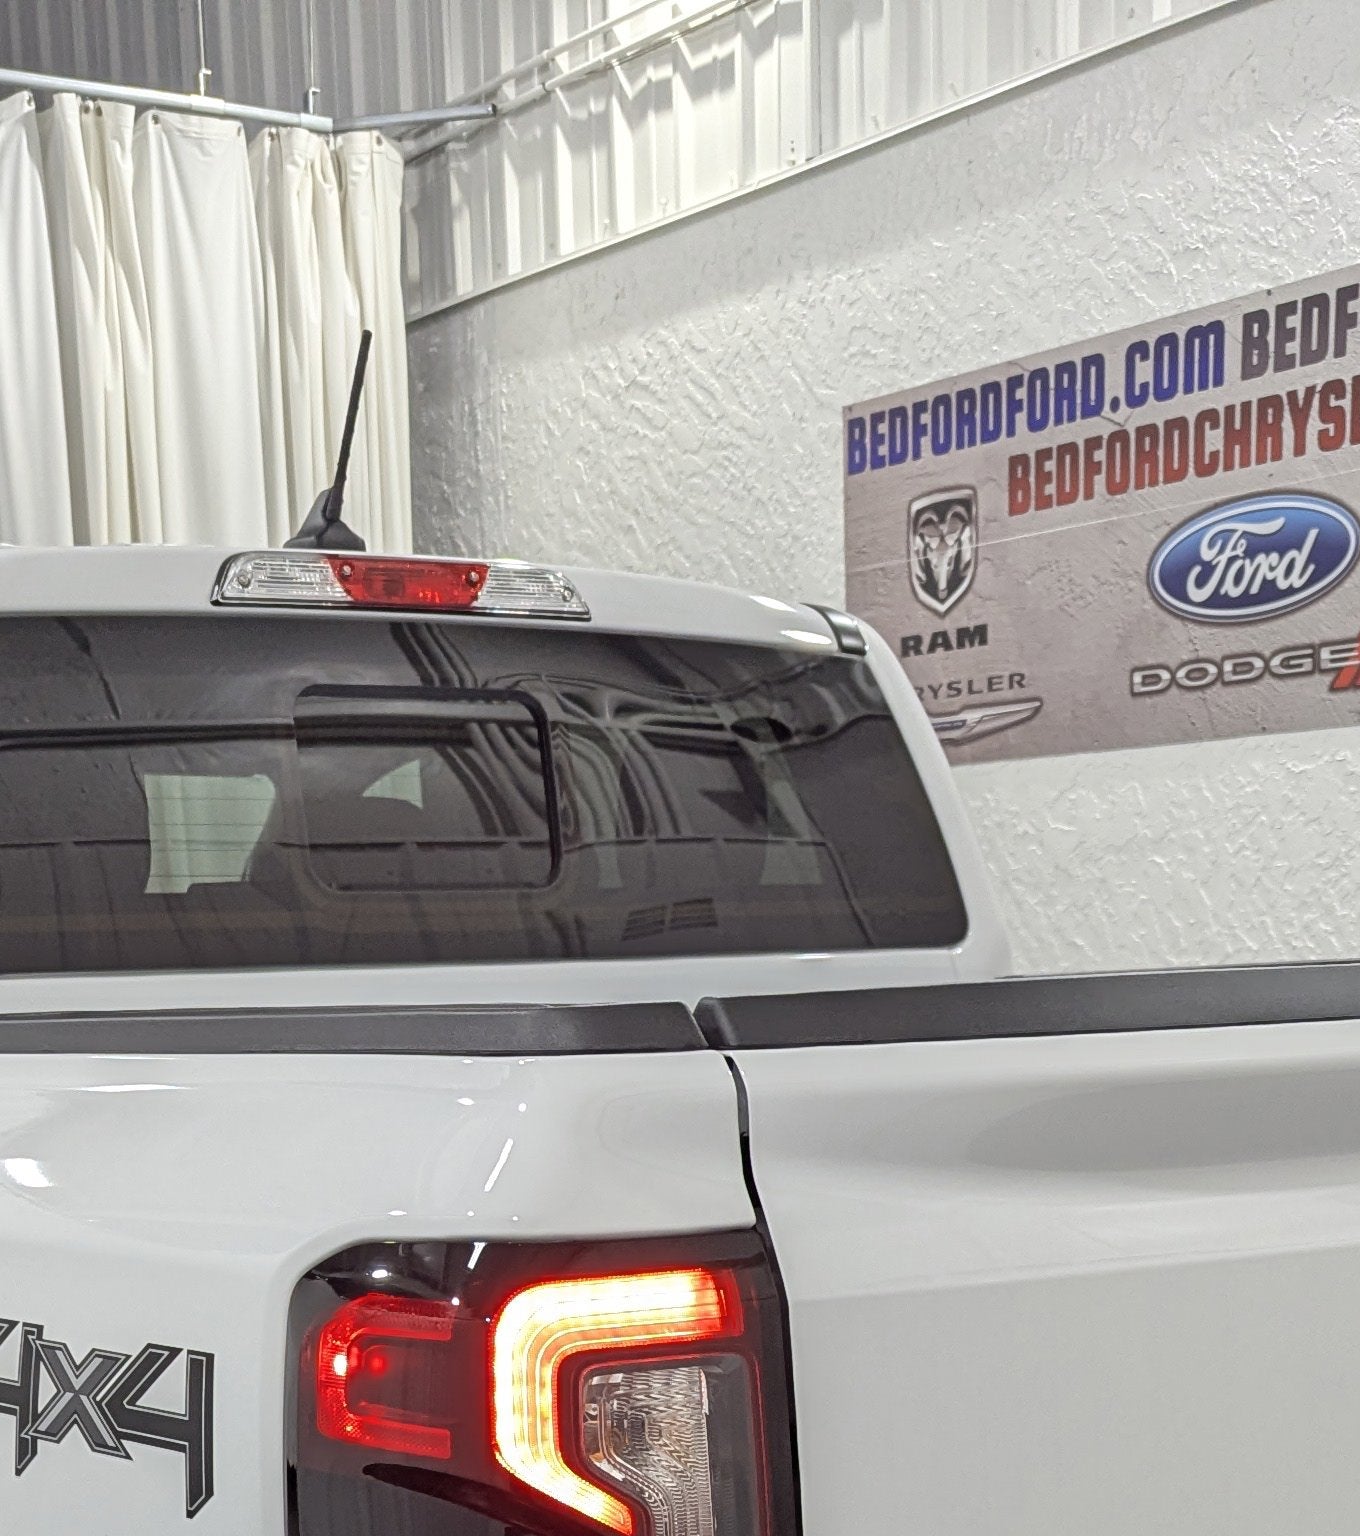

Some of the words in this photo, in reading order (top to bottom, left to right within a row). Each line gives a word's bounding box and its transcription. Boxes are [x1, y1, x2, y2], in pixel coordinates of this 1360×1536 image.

[847, 319, 1225, 475] BEDFORDFORD.COM
[1186, 516, 1319, 602] Ford
[900, 624, 988, 658] RAM
[914, 672, 1027, 701] RYSLER
